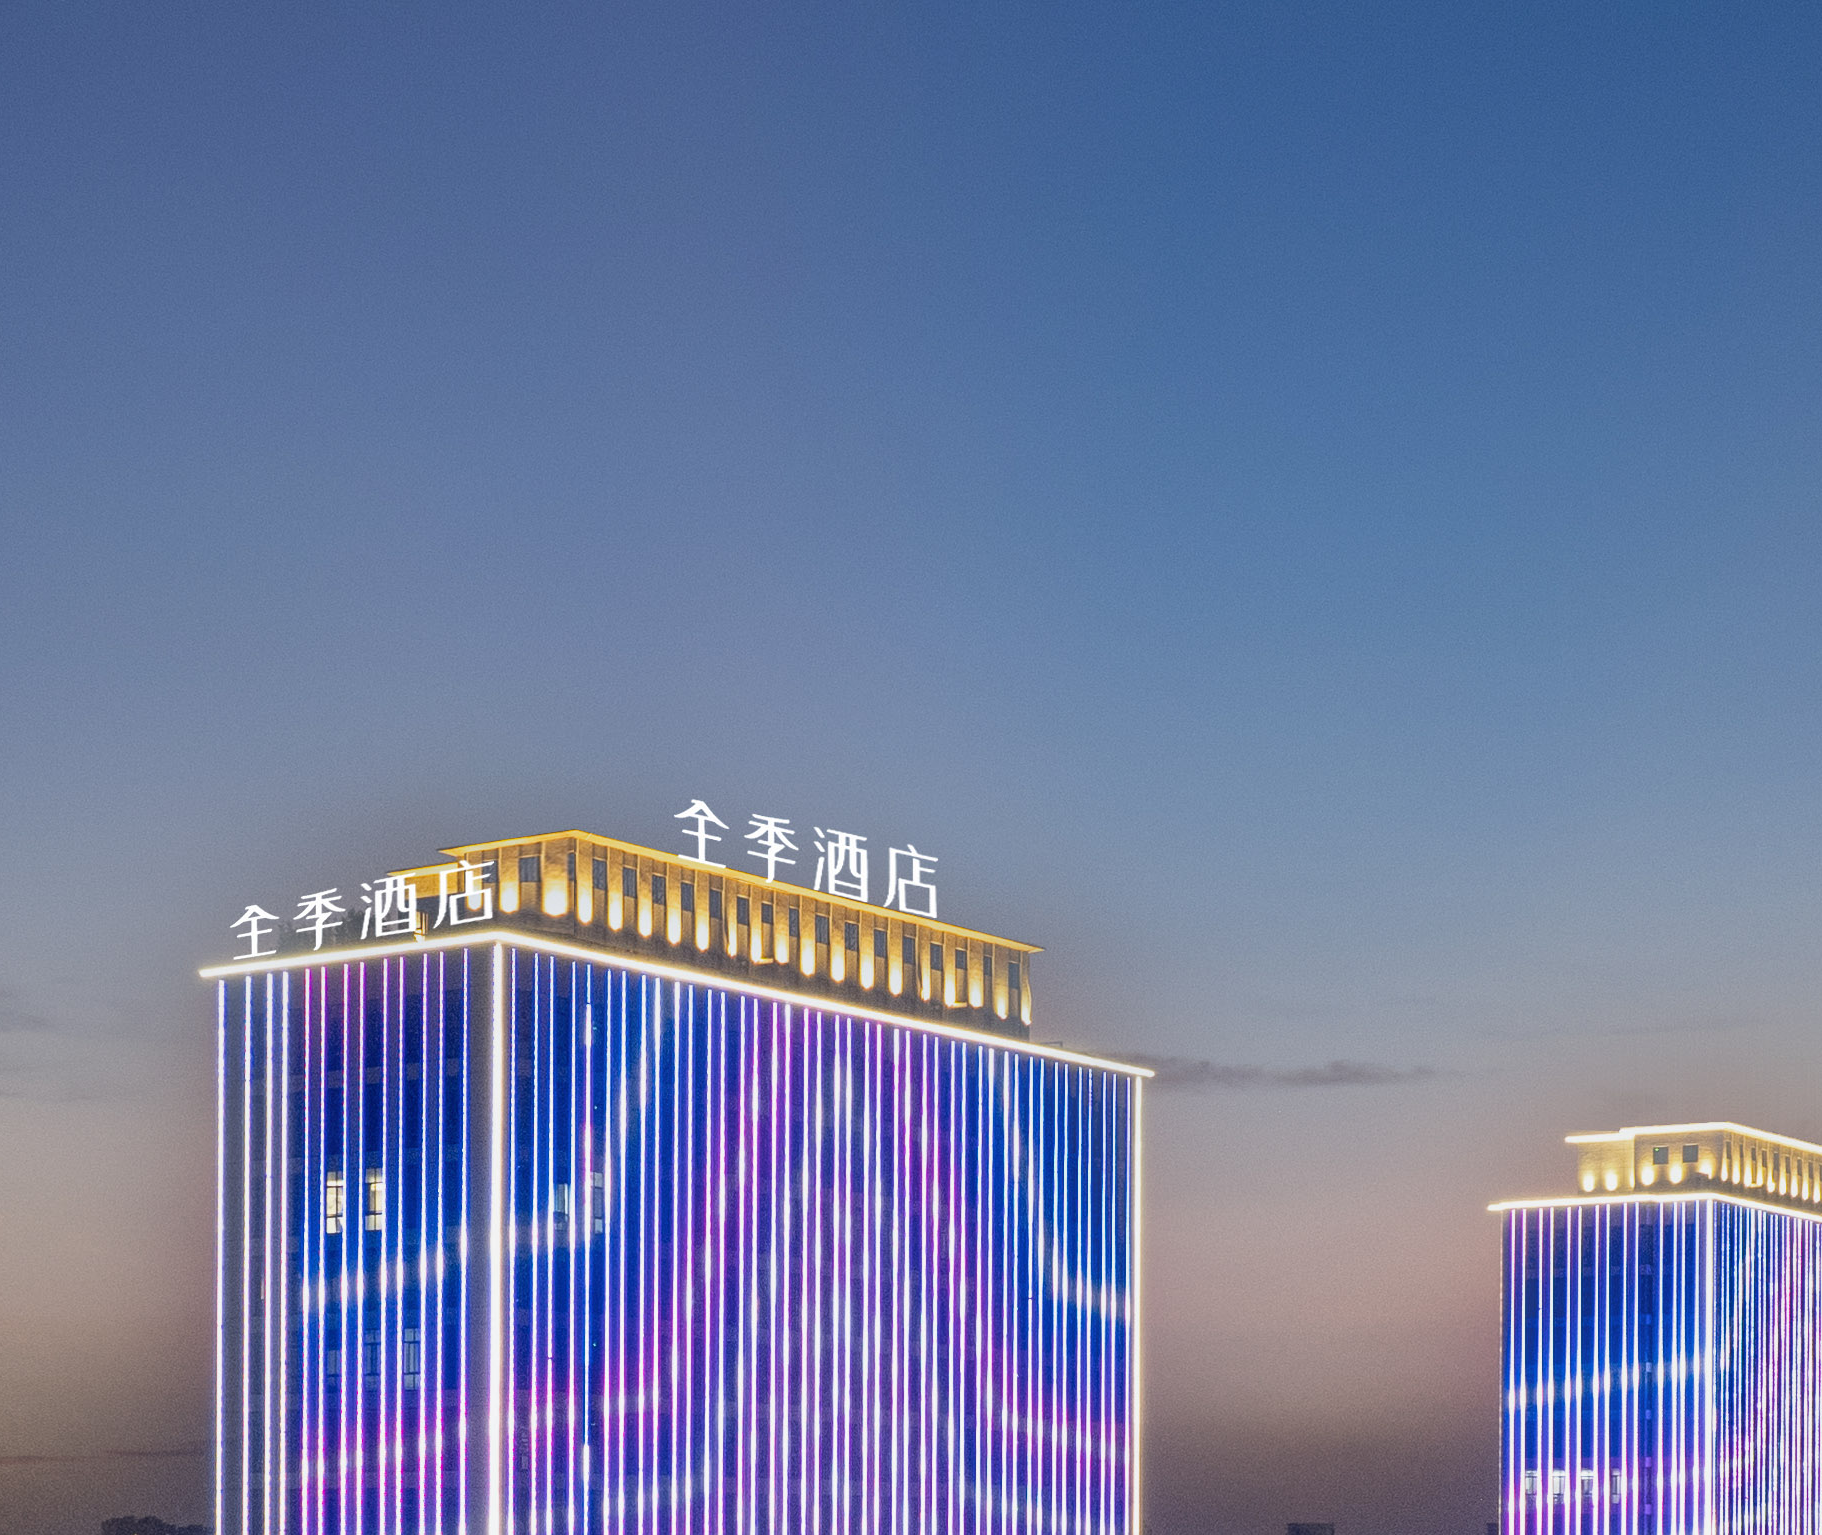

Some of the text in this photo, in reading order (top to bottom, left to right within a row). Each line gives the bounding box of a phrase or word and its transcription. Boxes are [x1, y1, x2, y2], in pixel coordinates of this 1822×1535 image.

[230, 860, 495, 960] 全季酒店
[673, 799, 938, 919] 全季酒店
